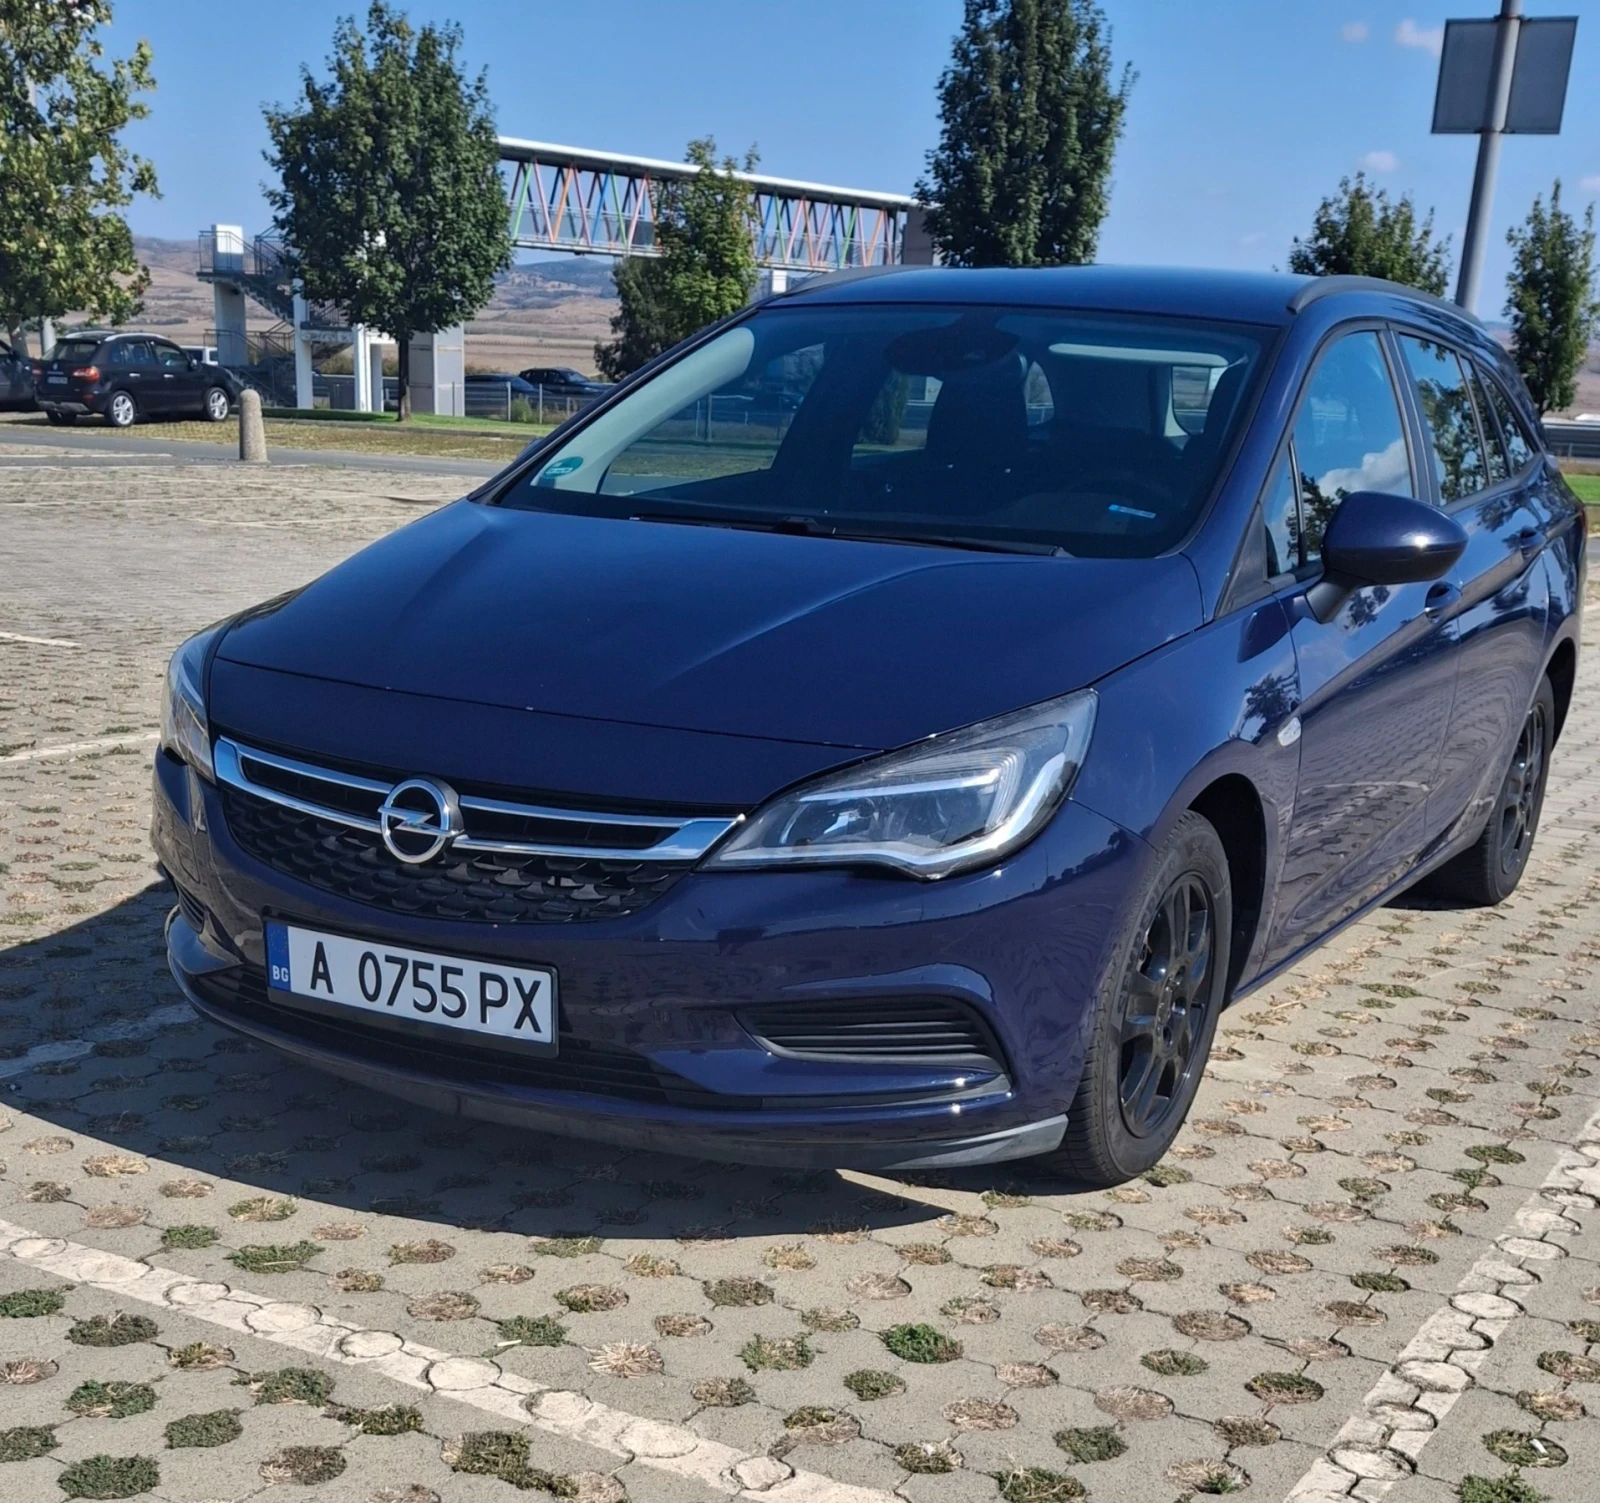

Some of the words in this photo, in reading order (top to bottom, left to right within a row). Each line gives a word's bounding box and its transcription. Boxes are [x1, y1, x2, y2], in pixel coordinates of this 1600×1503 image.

[272, 964, 289, 982] BG
[310, 941, 334, 994] A
[358, 951, 467, 1019] 0755
[479, 971, 542, 1033] PX
[1117, 871, 1168, 1013] SEMPERIT
